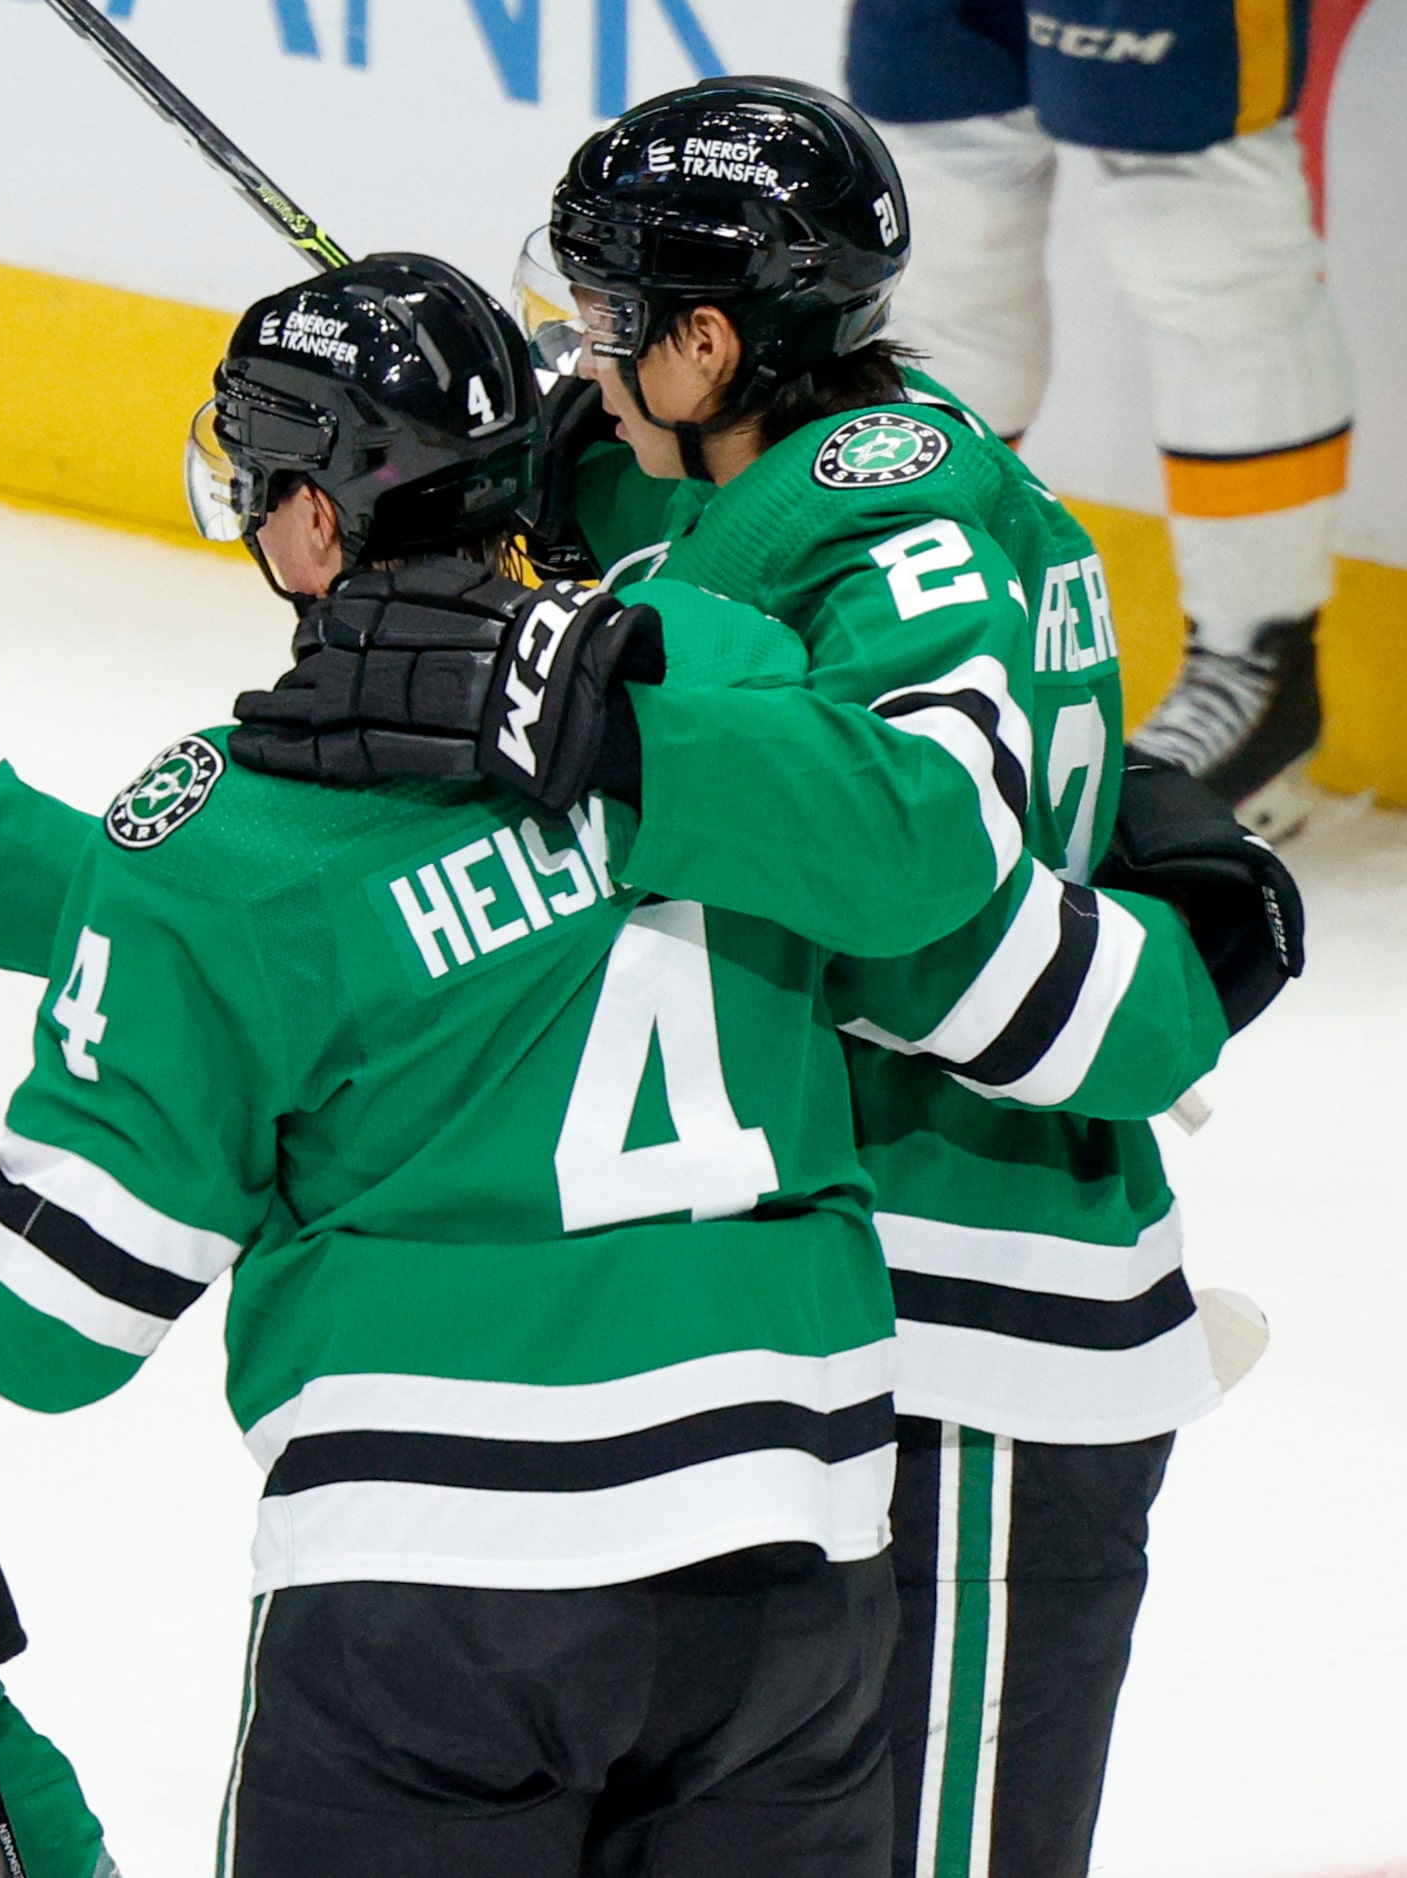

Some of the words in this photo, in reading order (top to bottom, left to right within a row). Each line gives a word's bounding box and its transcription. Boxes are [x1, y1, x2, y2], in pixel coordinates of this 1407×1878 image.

[1027, 13, 1176, 65] CCM
[682, 156, 779, 187] TRANSFER
[683, 137, 762, 164] ENERGY
[872, 191, 899, 247] 21
[281, 329, 360, 364] TRANSFER
[285, 310, 349, 340] ENERGY
[467, 374, 495, 425] 4
[822, 416, 934, 462] DALLAS
[831, 451, 934, 483] STARS
[51, 924, 111, 1082] 4
[553, 898, 780, 1232] 4
